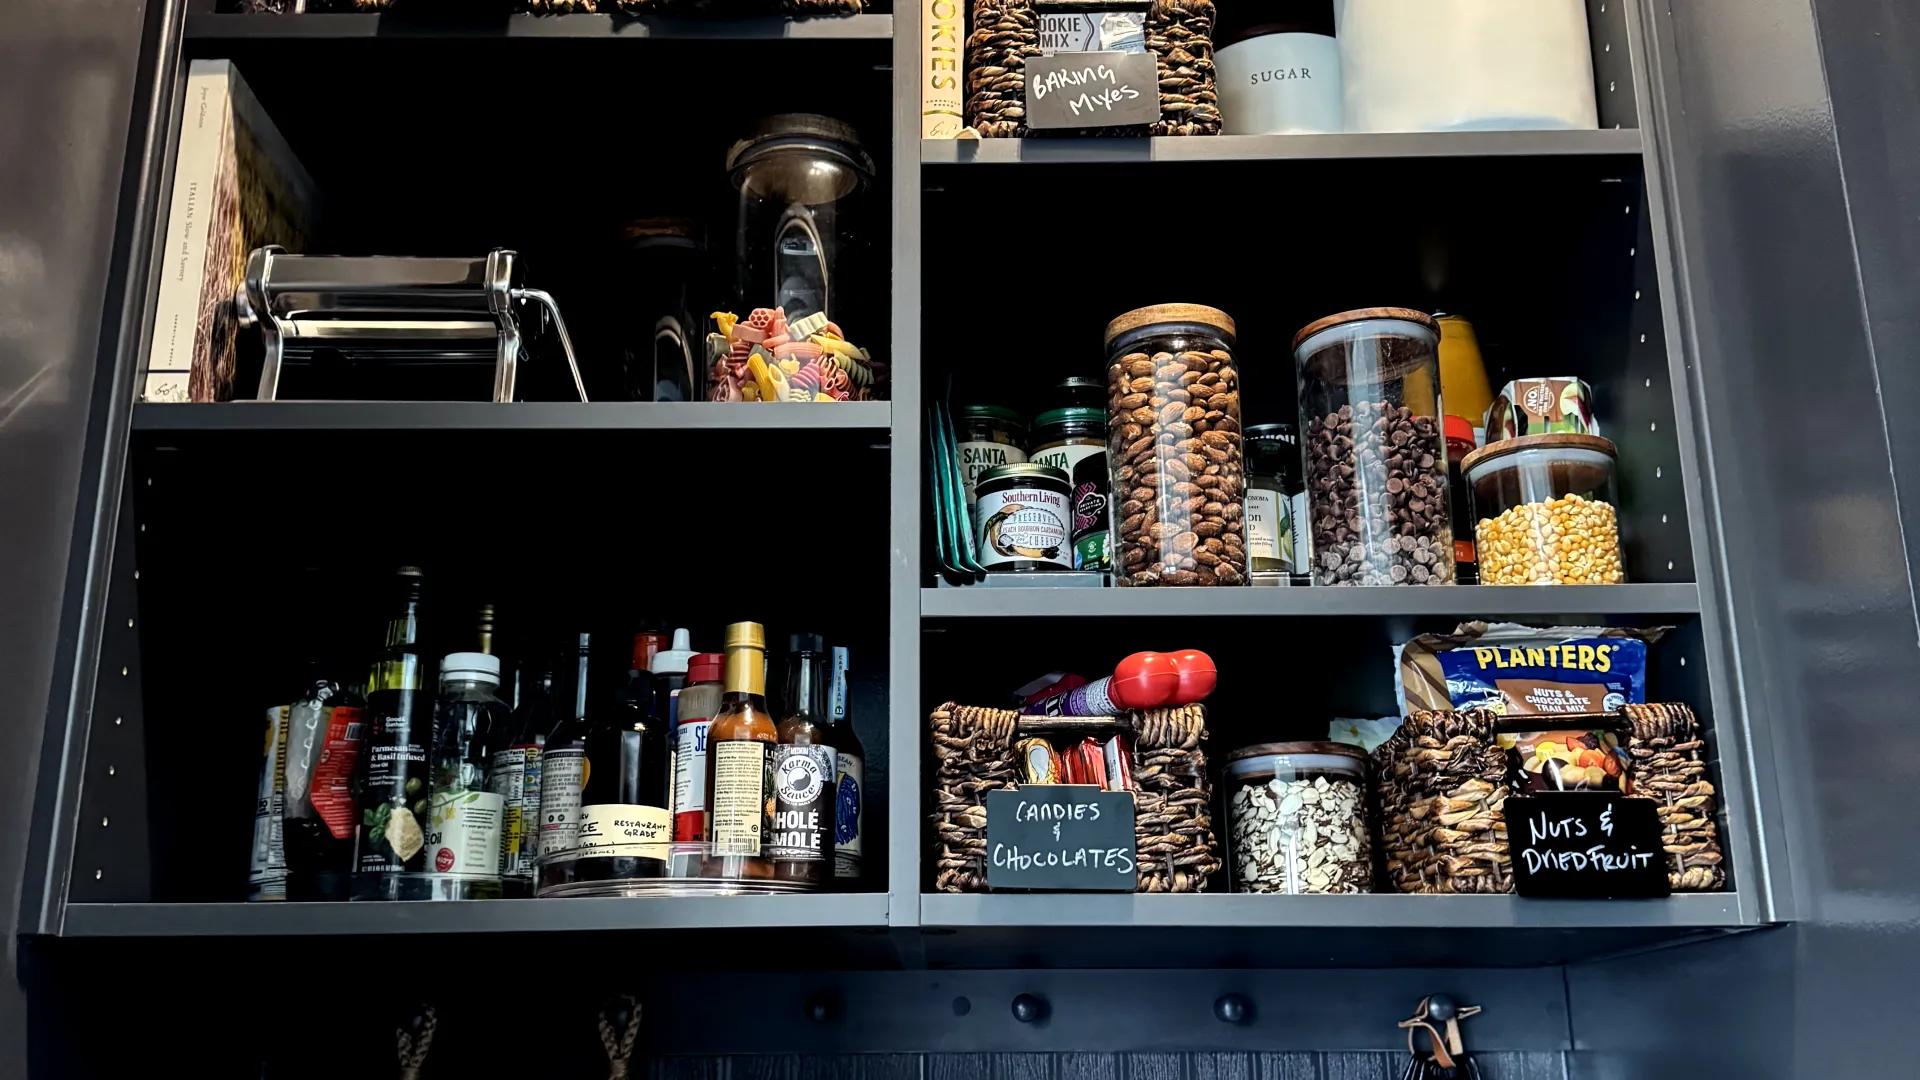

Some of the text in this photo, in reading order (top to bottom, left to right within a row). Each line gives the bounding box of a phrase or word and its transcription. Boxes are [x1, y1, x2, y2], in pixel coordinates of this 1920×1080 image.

[1041, 33, 1069, 48] MIX
[1033, 65, 1116, 100] BAKING
[1251, 68, 1311, 85] SUGAR
[177, 182, 197, 282] ITALIAN Slow and Savory
[1527, 390, 1538, 407] NO
[964, 447, 1007, 464] SANTA
[1002, 490, 1060, 508] Southern Living
[1013, 511, 1055, 524] PRESERVES
[1029, 535, 1057, 546] CHEESE
[1474, 644, 1611, 673] PLANTERS
[1525, 695, 1591, 705] CHOCOLATE
[1533, 687, 1575, 698] NUTS &
[1535, 703, 1587, 712] TRAIL MIX
[694, 724, 707, 753] SE
[371, 745, 408, 753] Parmesan
[377, 753, 396, 761] Basil
[396, 752, 426, 762] Infused
[780, 784, 815, 800] Sauce
[776, 808, 819, 830] HOLÉ
[1016, 801, 1100, 822] CANDIES
[614, 820, 666, 832] RESTAURANT
[1053, 821, 1061, 842] &
[1529, 803, 1614, 845] NUTS &
[430, 831, 442, 845] Oil
[624, 828, 656, 839] GRADE
[993, 843, 1134, 874] CHOCOLATES
